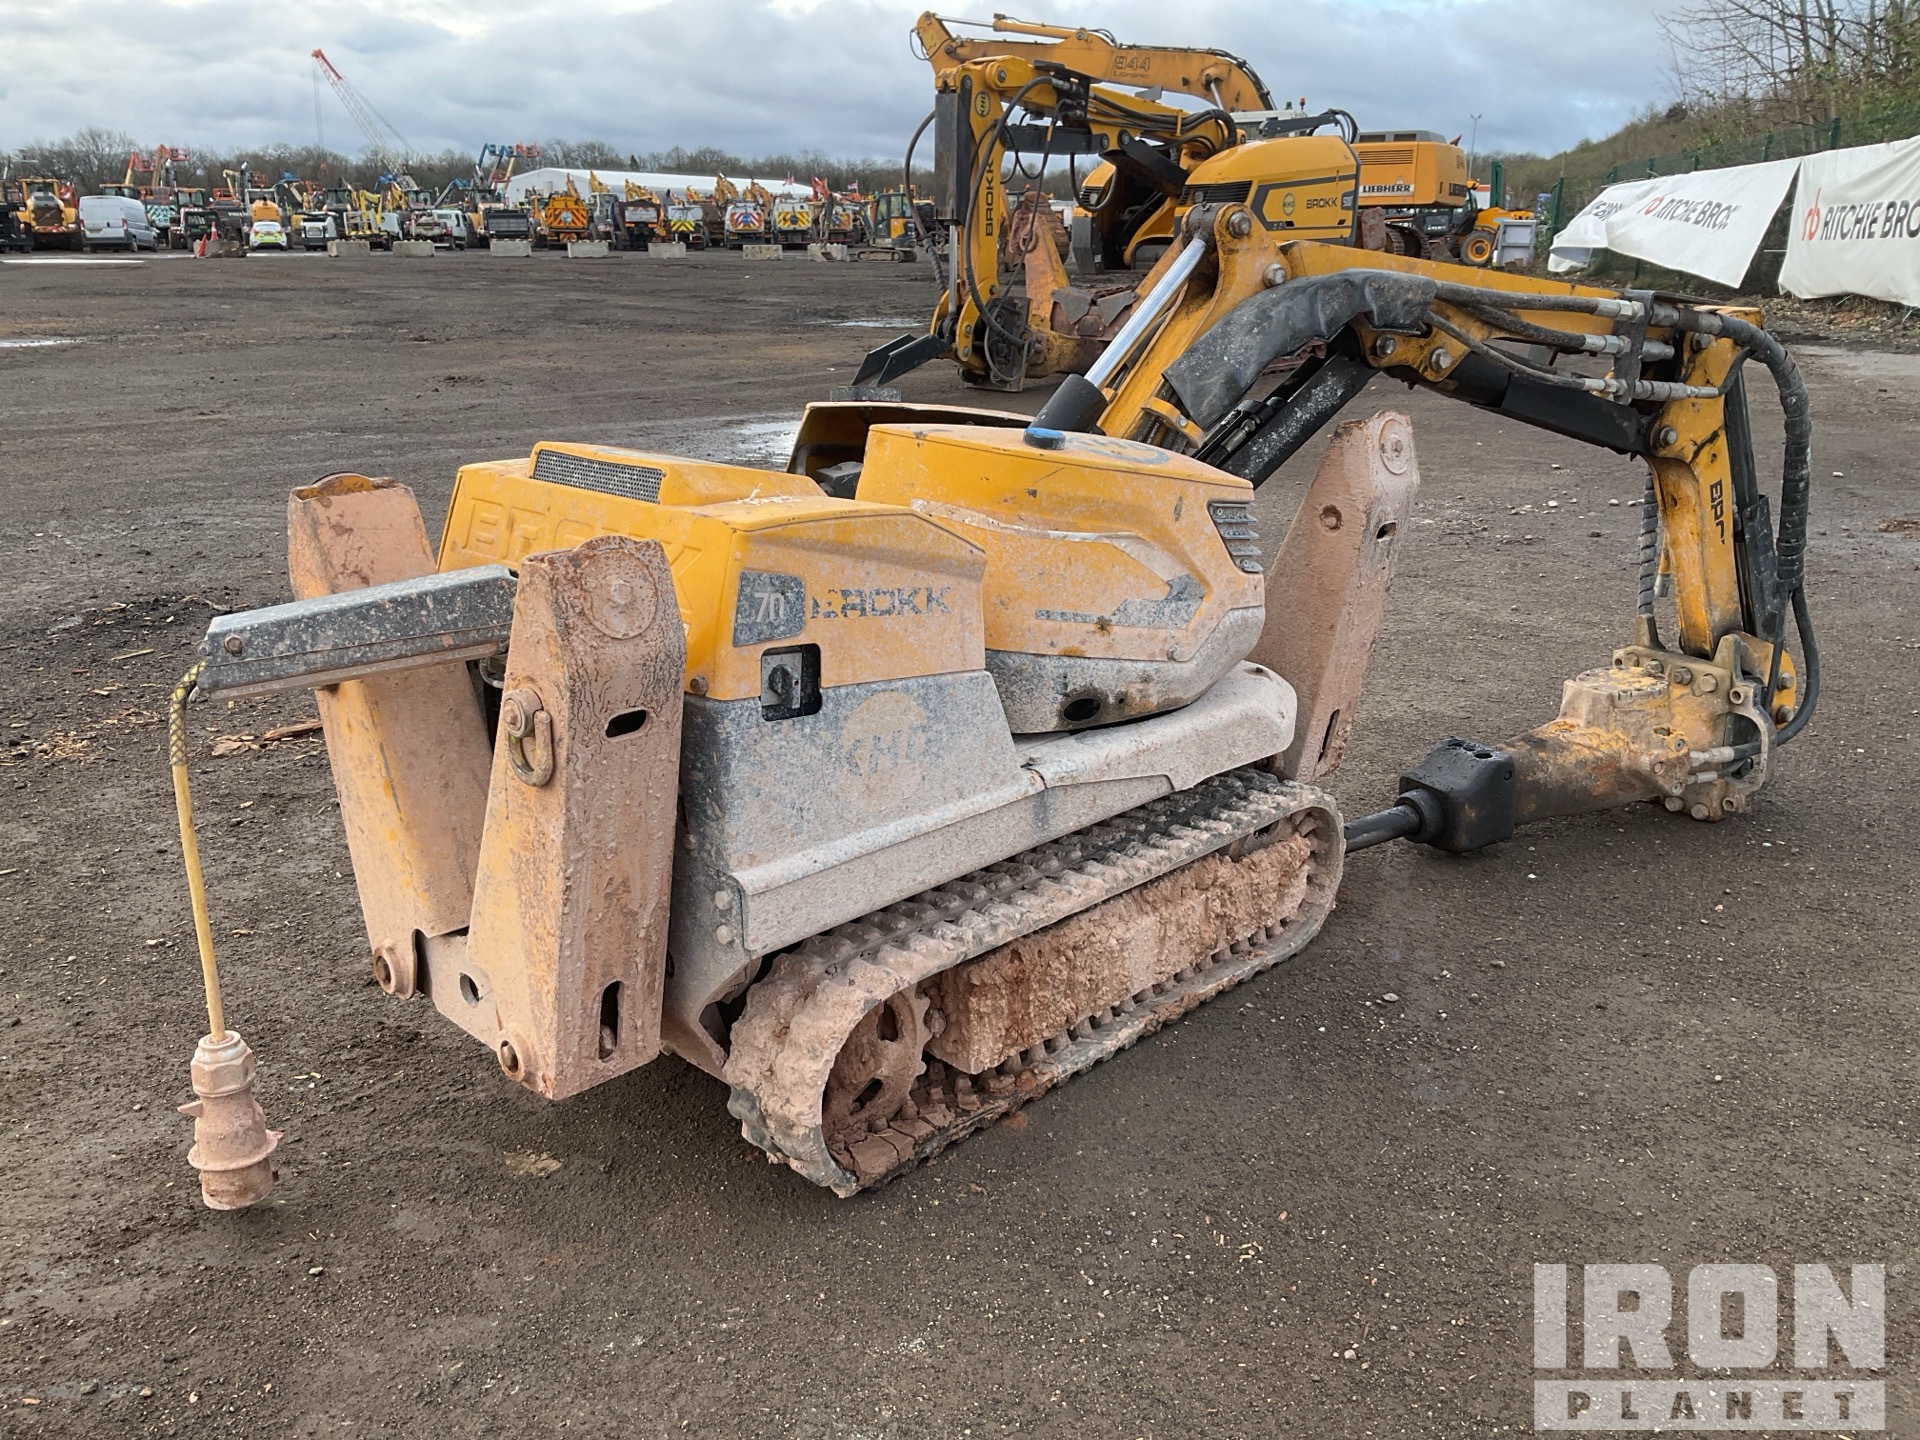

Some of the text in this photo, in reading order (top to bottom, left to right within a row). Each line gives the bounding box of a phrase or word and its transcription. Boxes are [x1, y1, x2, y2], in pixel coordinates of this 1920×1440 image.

[1114, 55, 1151, 71] 944
[985, 159, 994, 236] BROKK
[1362, 184, 1411, 193] LIEBHERR
[1306, 197, 1338, 209] BROKK
[1820, 202, 1885, 241] RITCHIE
[755, 591, 786, 623] 70
